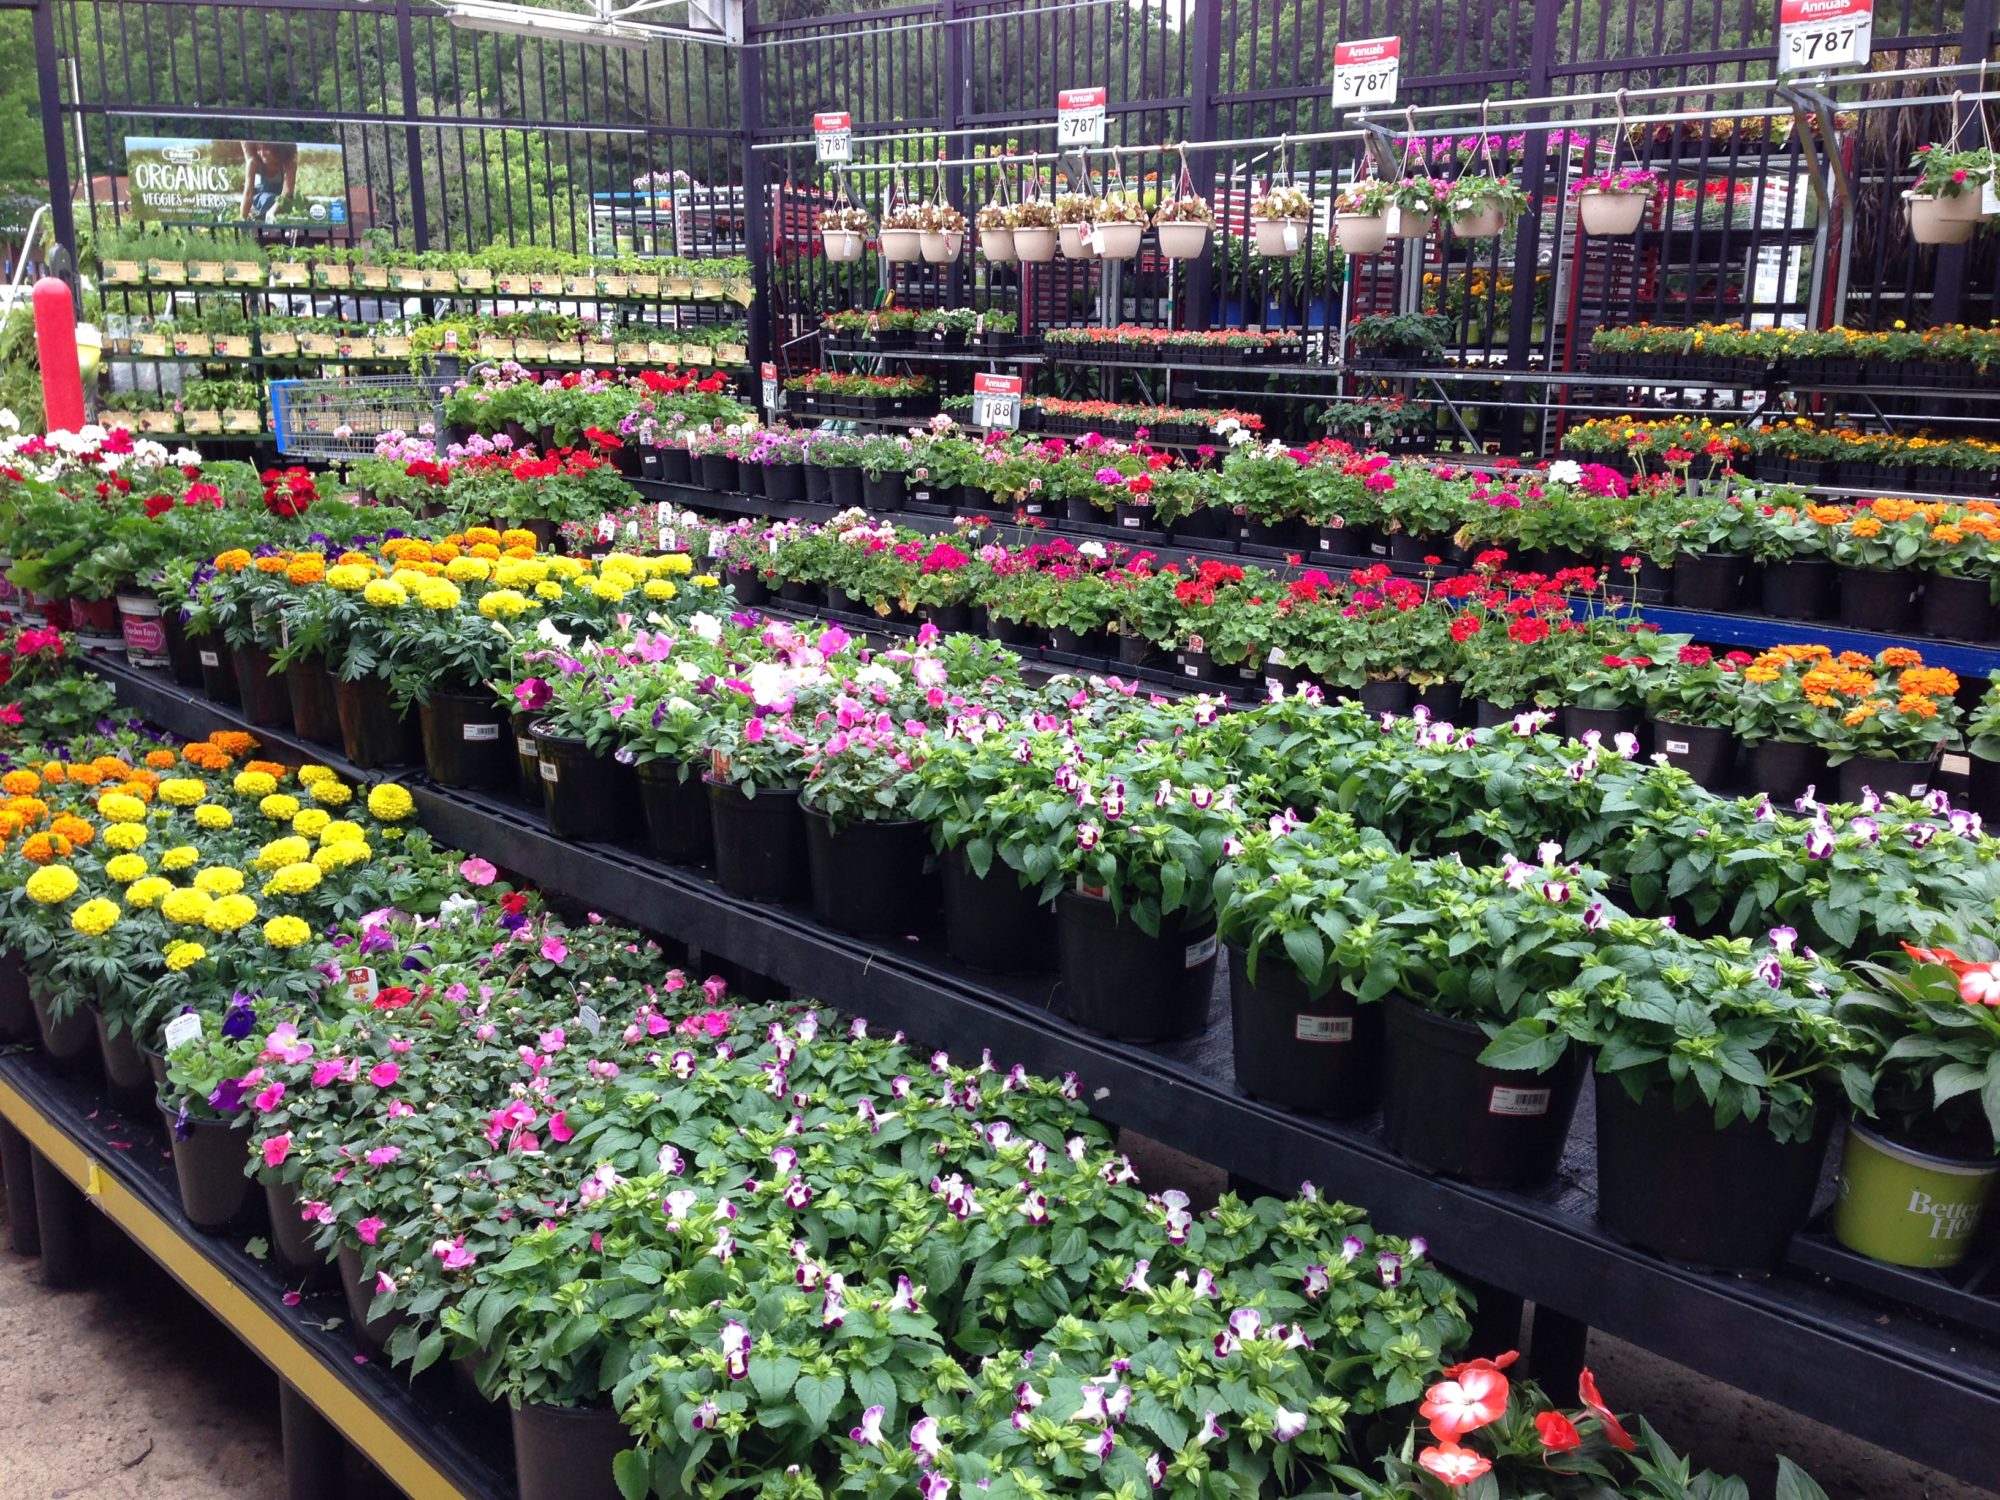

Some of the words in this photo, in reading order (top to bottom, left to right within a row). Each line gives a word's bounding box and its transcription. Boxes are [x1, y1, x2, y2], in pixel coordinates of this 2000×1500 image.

[1801, 0, 1851, 13] Annuals
[1348, 43, 1385, 58] Annuals
[135, 163, 230, 192] ORGANICS
[142, 192, 182, 206] VEGGIES
[196, 193, 227, 207] HERBS
[1905, 1188, 1983, 1219] Better
